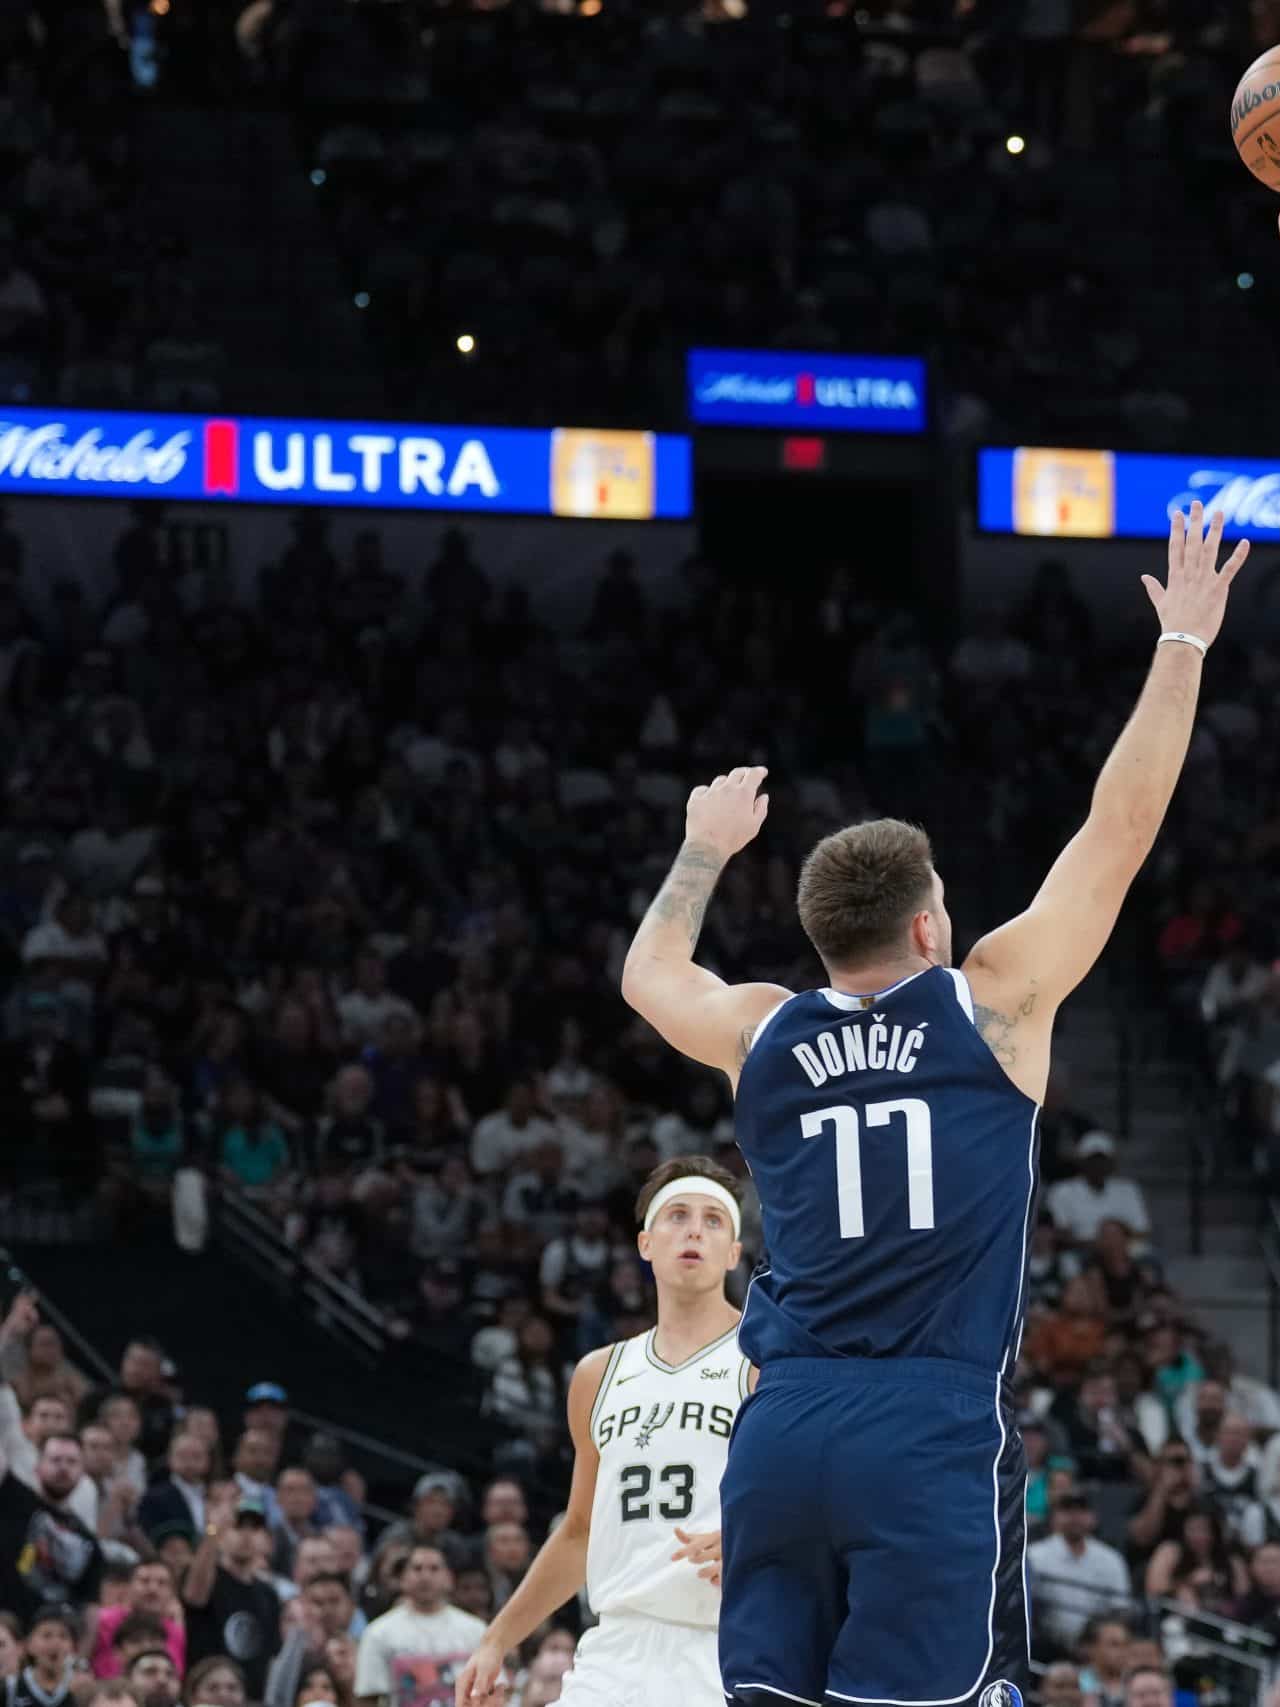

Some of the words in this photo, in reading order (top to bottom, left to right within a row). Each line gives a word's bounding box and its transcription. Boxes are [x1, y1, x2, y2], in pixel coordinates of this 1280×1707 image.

[253, 431, 500, 498] ULTRA
[792, 1013, 928, 1088] DONČIĆ
[800, 1098, 935, 1239] 77
[599, 1401, 734, 1449] SPURS
[618, 1463, 696, 1525] 23
